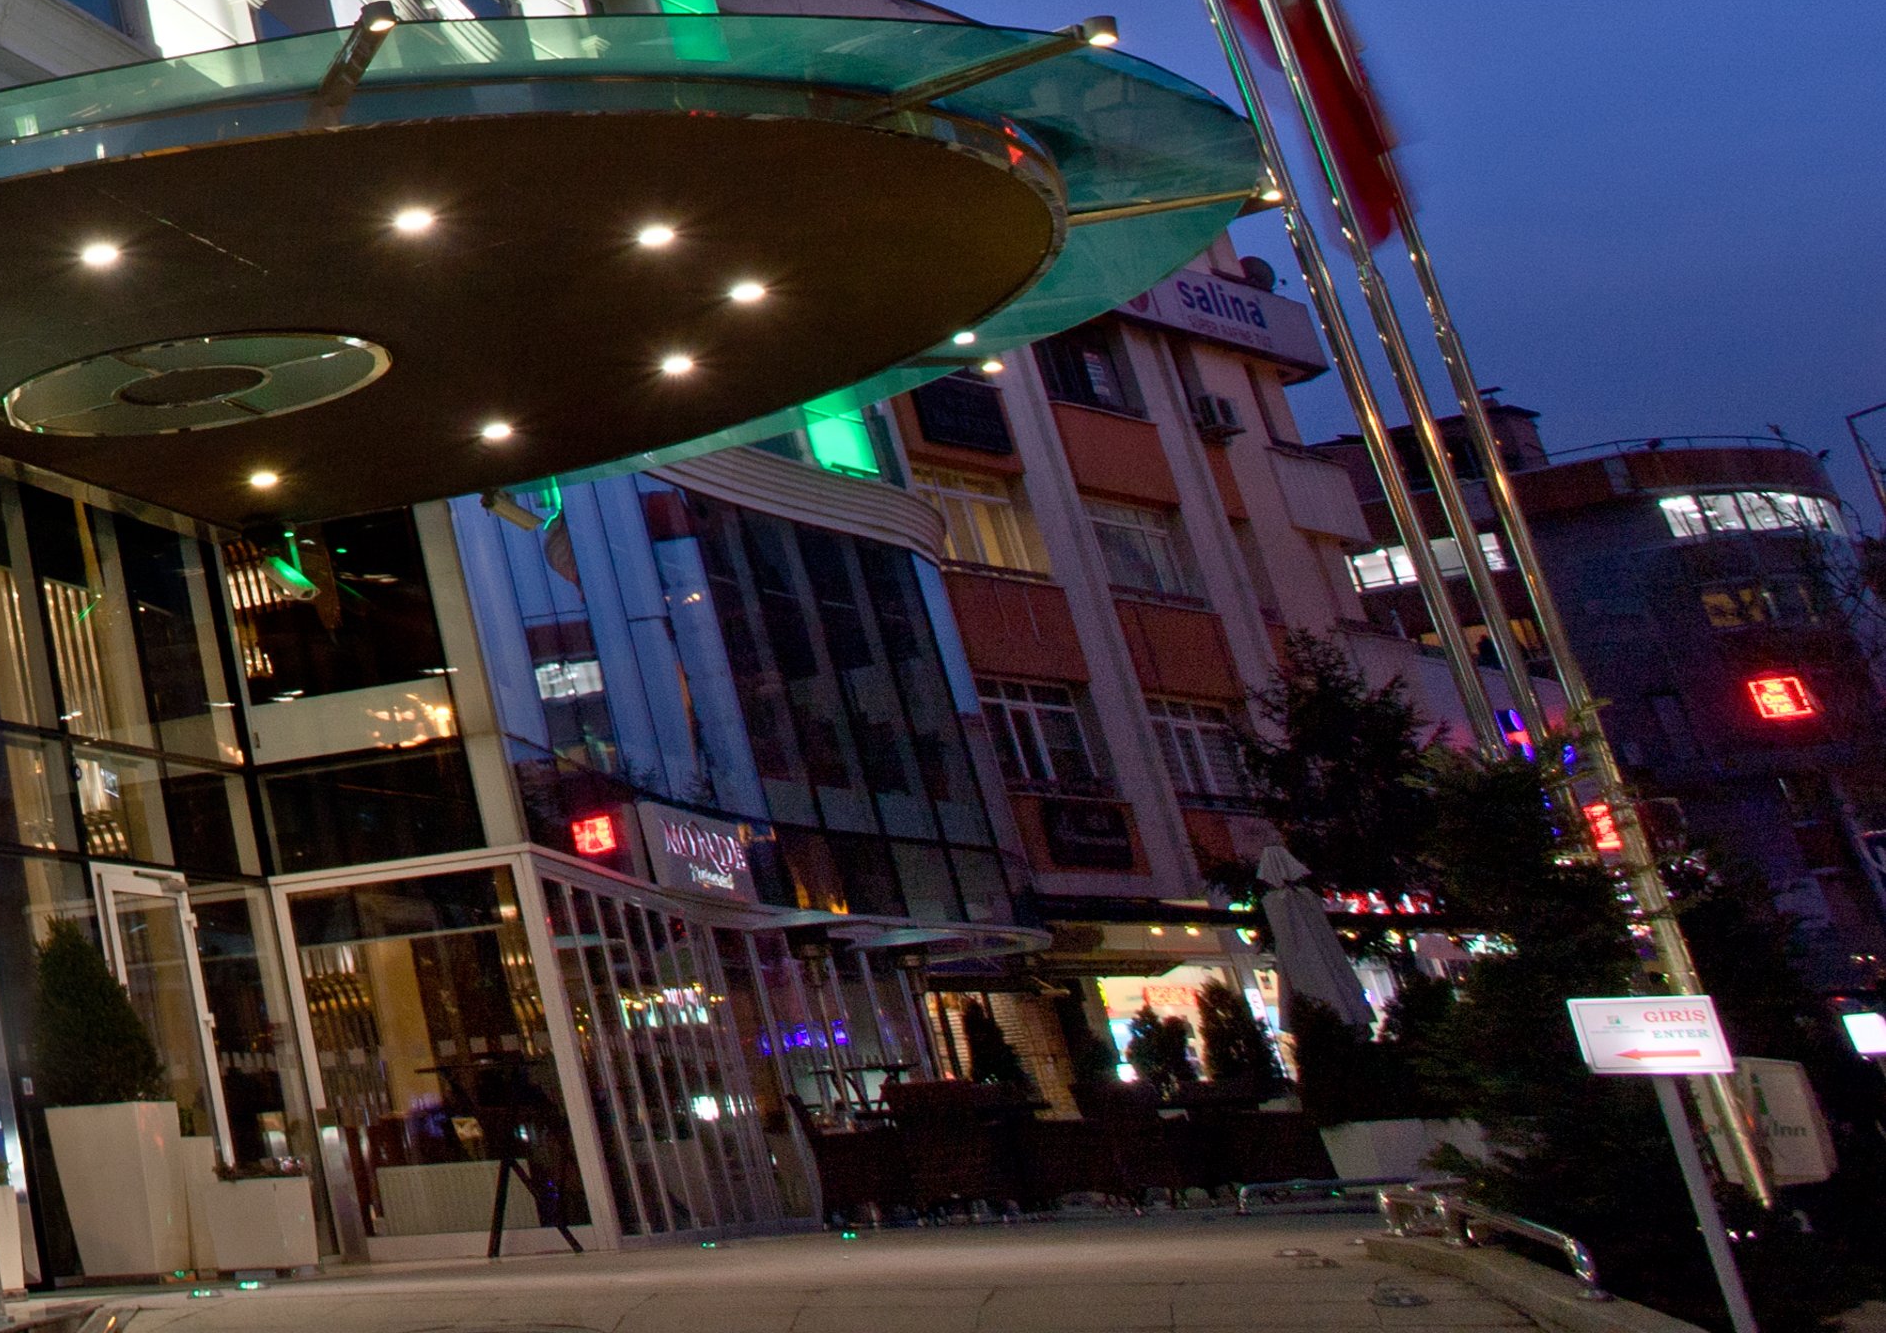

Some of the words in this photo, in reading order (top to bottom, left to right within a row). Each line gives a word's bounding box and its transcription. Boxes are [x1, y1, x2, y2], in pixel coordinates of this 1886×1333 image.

[1176, 279, 1267, 329] salina
[1643, 1007, 1707, 1024] GİRİŞ
[1652, 1028, 1710, 1039] ENTER
